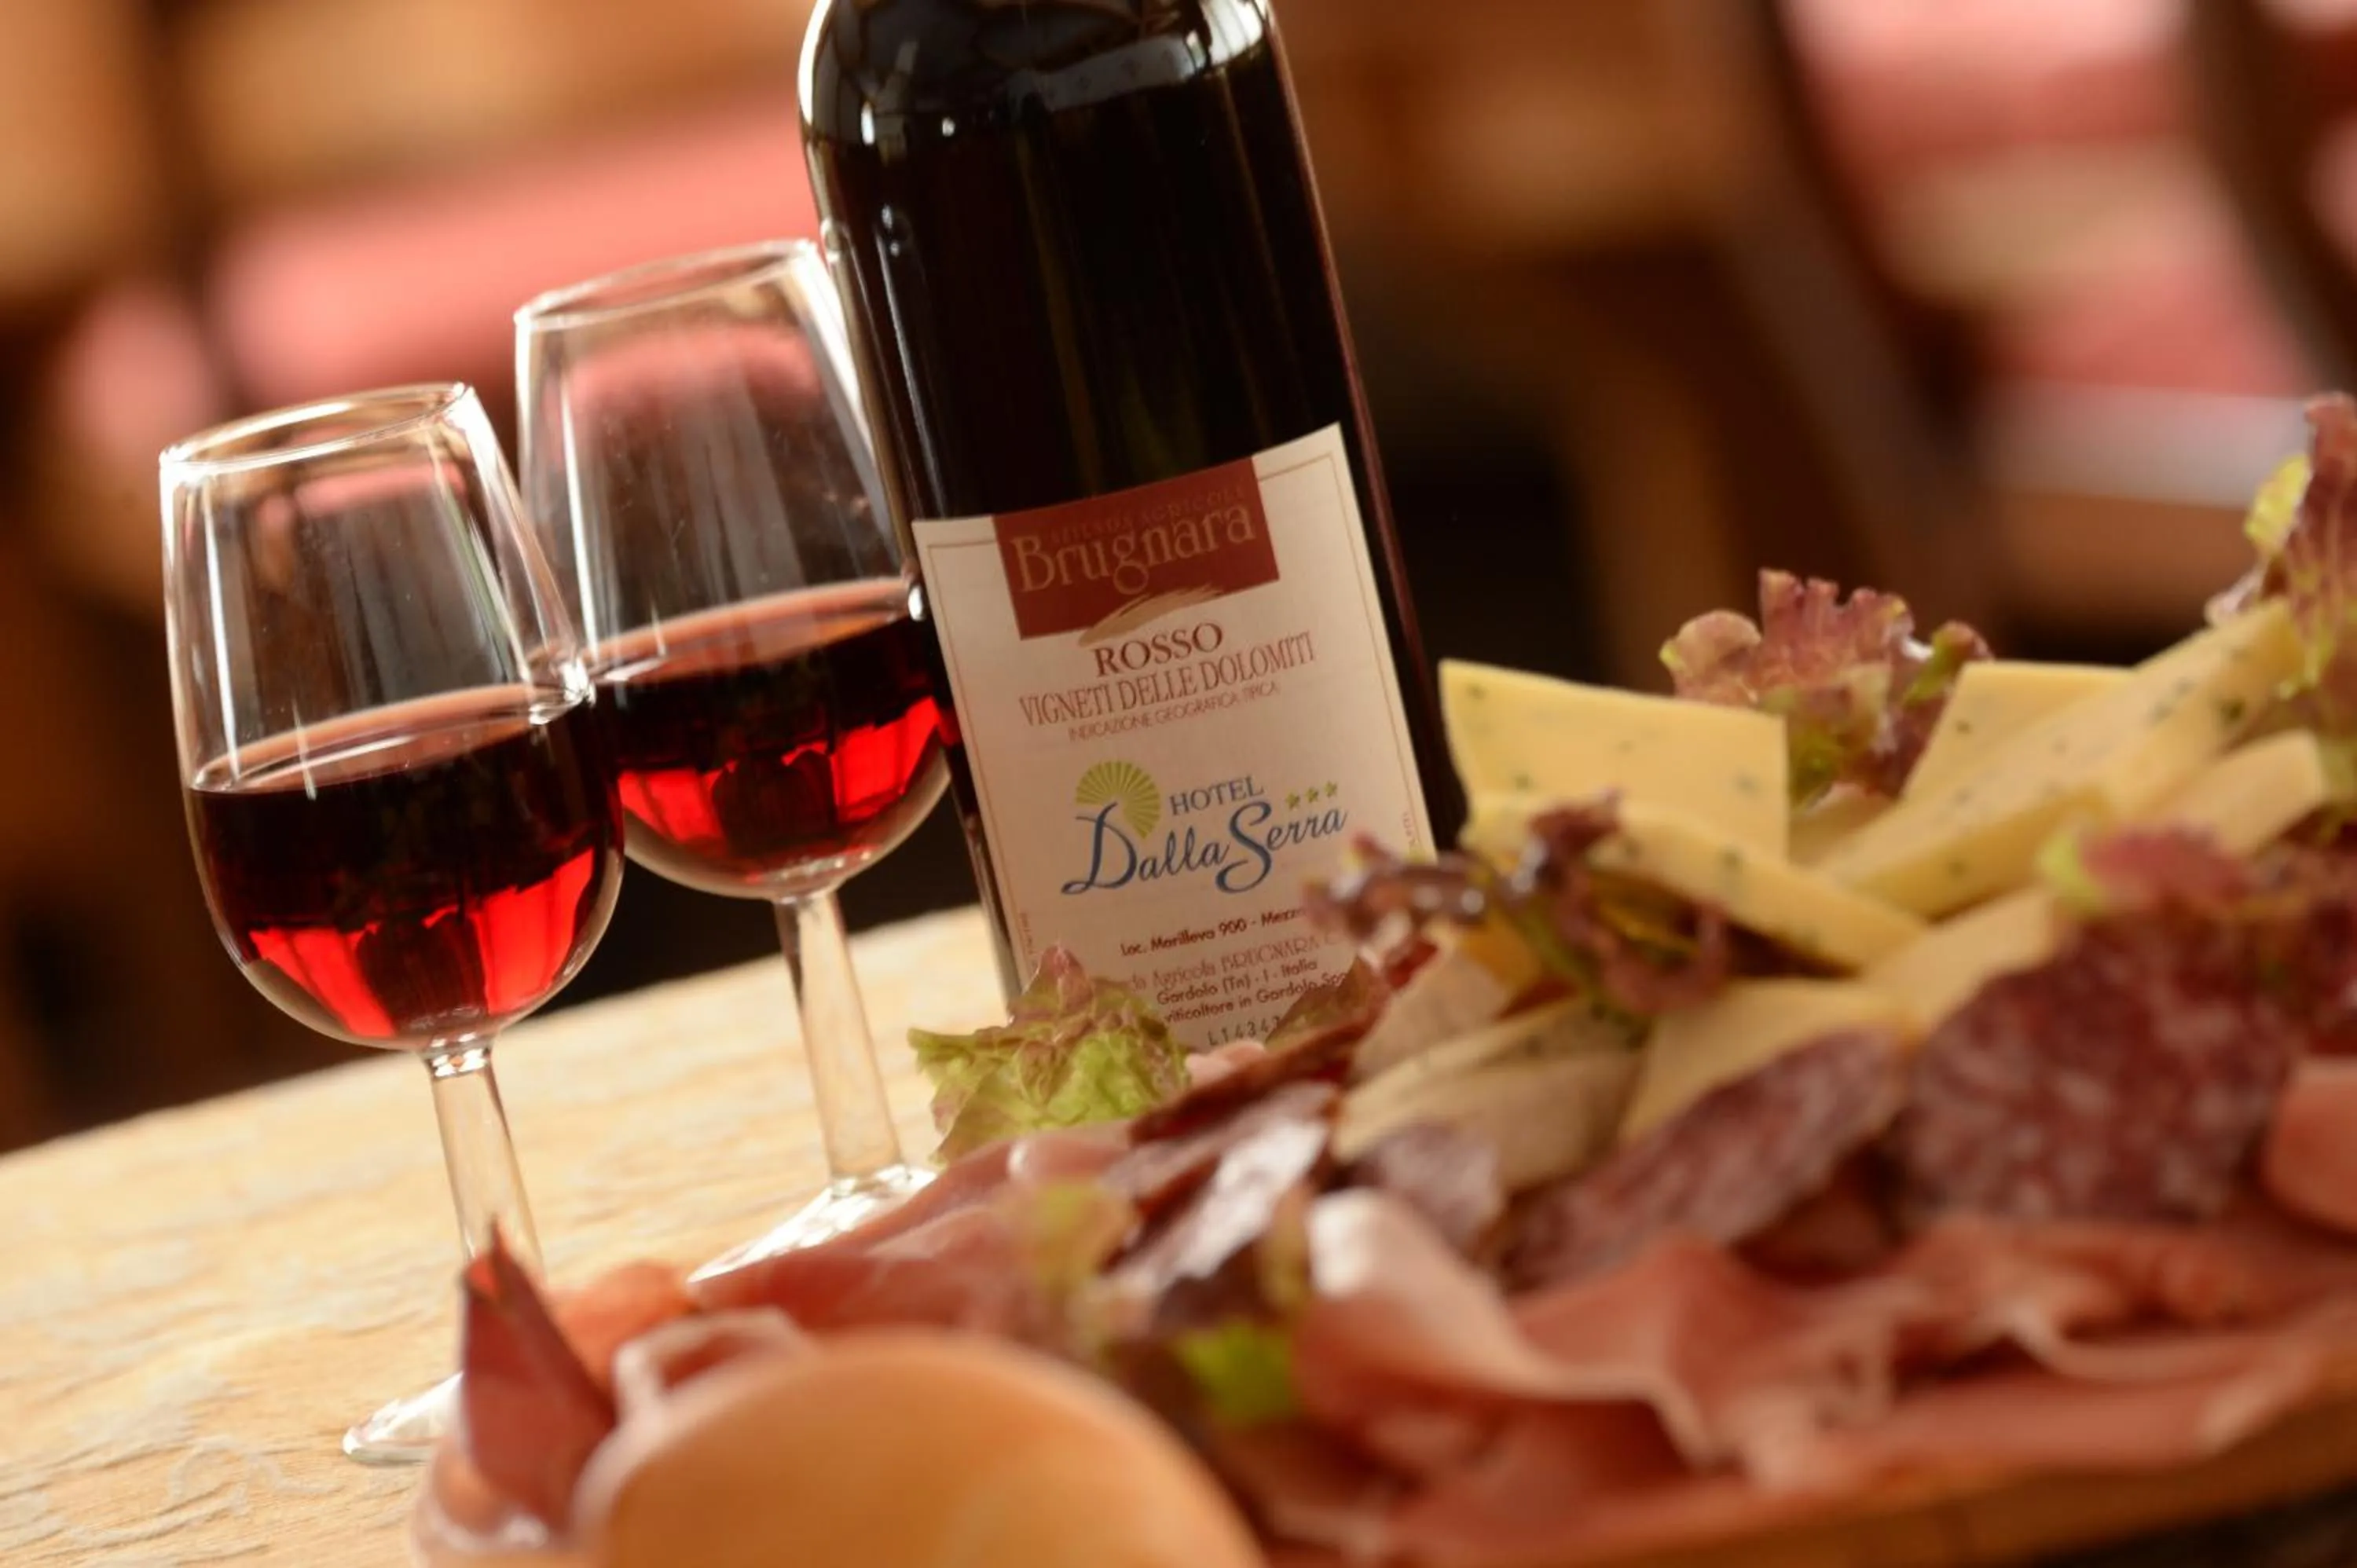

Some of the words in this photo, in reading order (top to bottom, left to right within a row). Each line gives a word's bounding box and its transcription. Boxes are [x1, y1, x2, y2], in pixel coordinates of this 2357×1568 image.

[1010, 504, 1255, 595] Brugnara
[1093, 623, 1223, 677] ROSSO
[1019, 684, 1113, 726] VIGNETI
[1119, 667, 1198, 710] DELLE
[1200, 632, 1317, 690] DOLOMITI
[1069, 715, 1153, 743] INDICAZIONE
[1155, 692, 1239, 727] GEOGRAFICA
[1169, 775, 1265, 816] HOTEL
[1061, 802, 1230, 894] Dalla
[1215, 801, 1348, 893] Serra
[1219, 918, 1248, 936] 900
